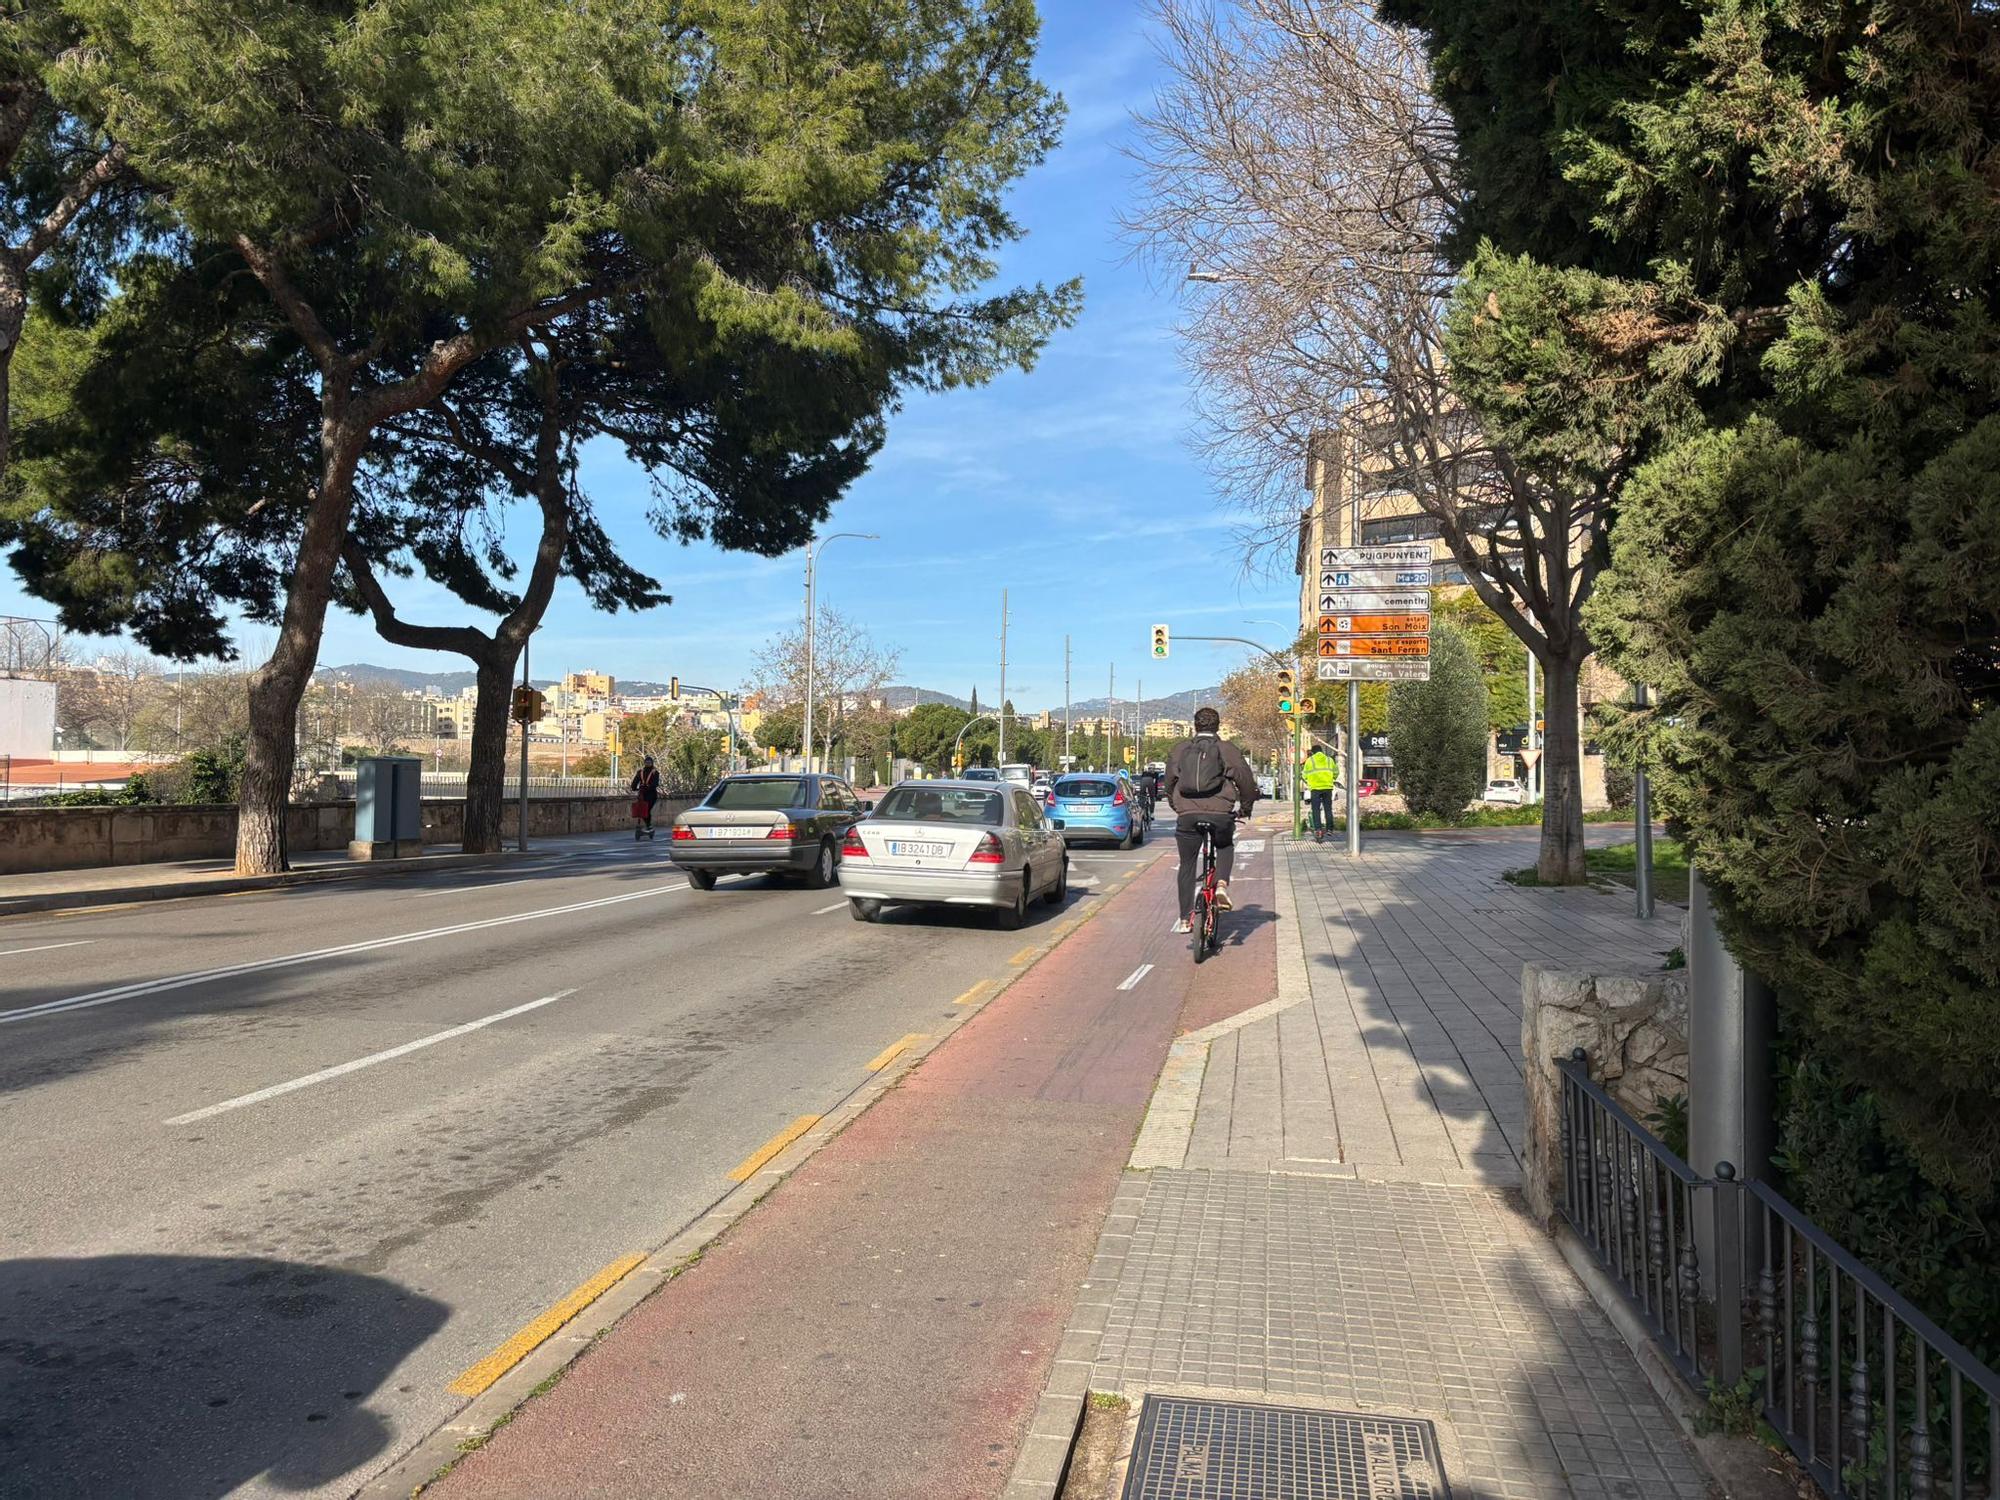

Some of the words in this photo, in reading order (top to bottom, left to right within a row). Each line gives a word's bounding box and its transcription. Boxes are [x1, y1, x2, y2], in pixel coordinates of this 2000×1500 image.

[1359, 551, 1428, 560] PUIGPUNYENT
[1397, 574, 1427, 582] Ma-20
[1384, 597, 1427, 605] cementiri
[1382, 623, 1400, 631] Son
[1370, 646, 1392, 654] Sant
[1398, 670, 1427, 678] Valero
[1180, 1446, 1203, 1476] PALMA
